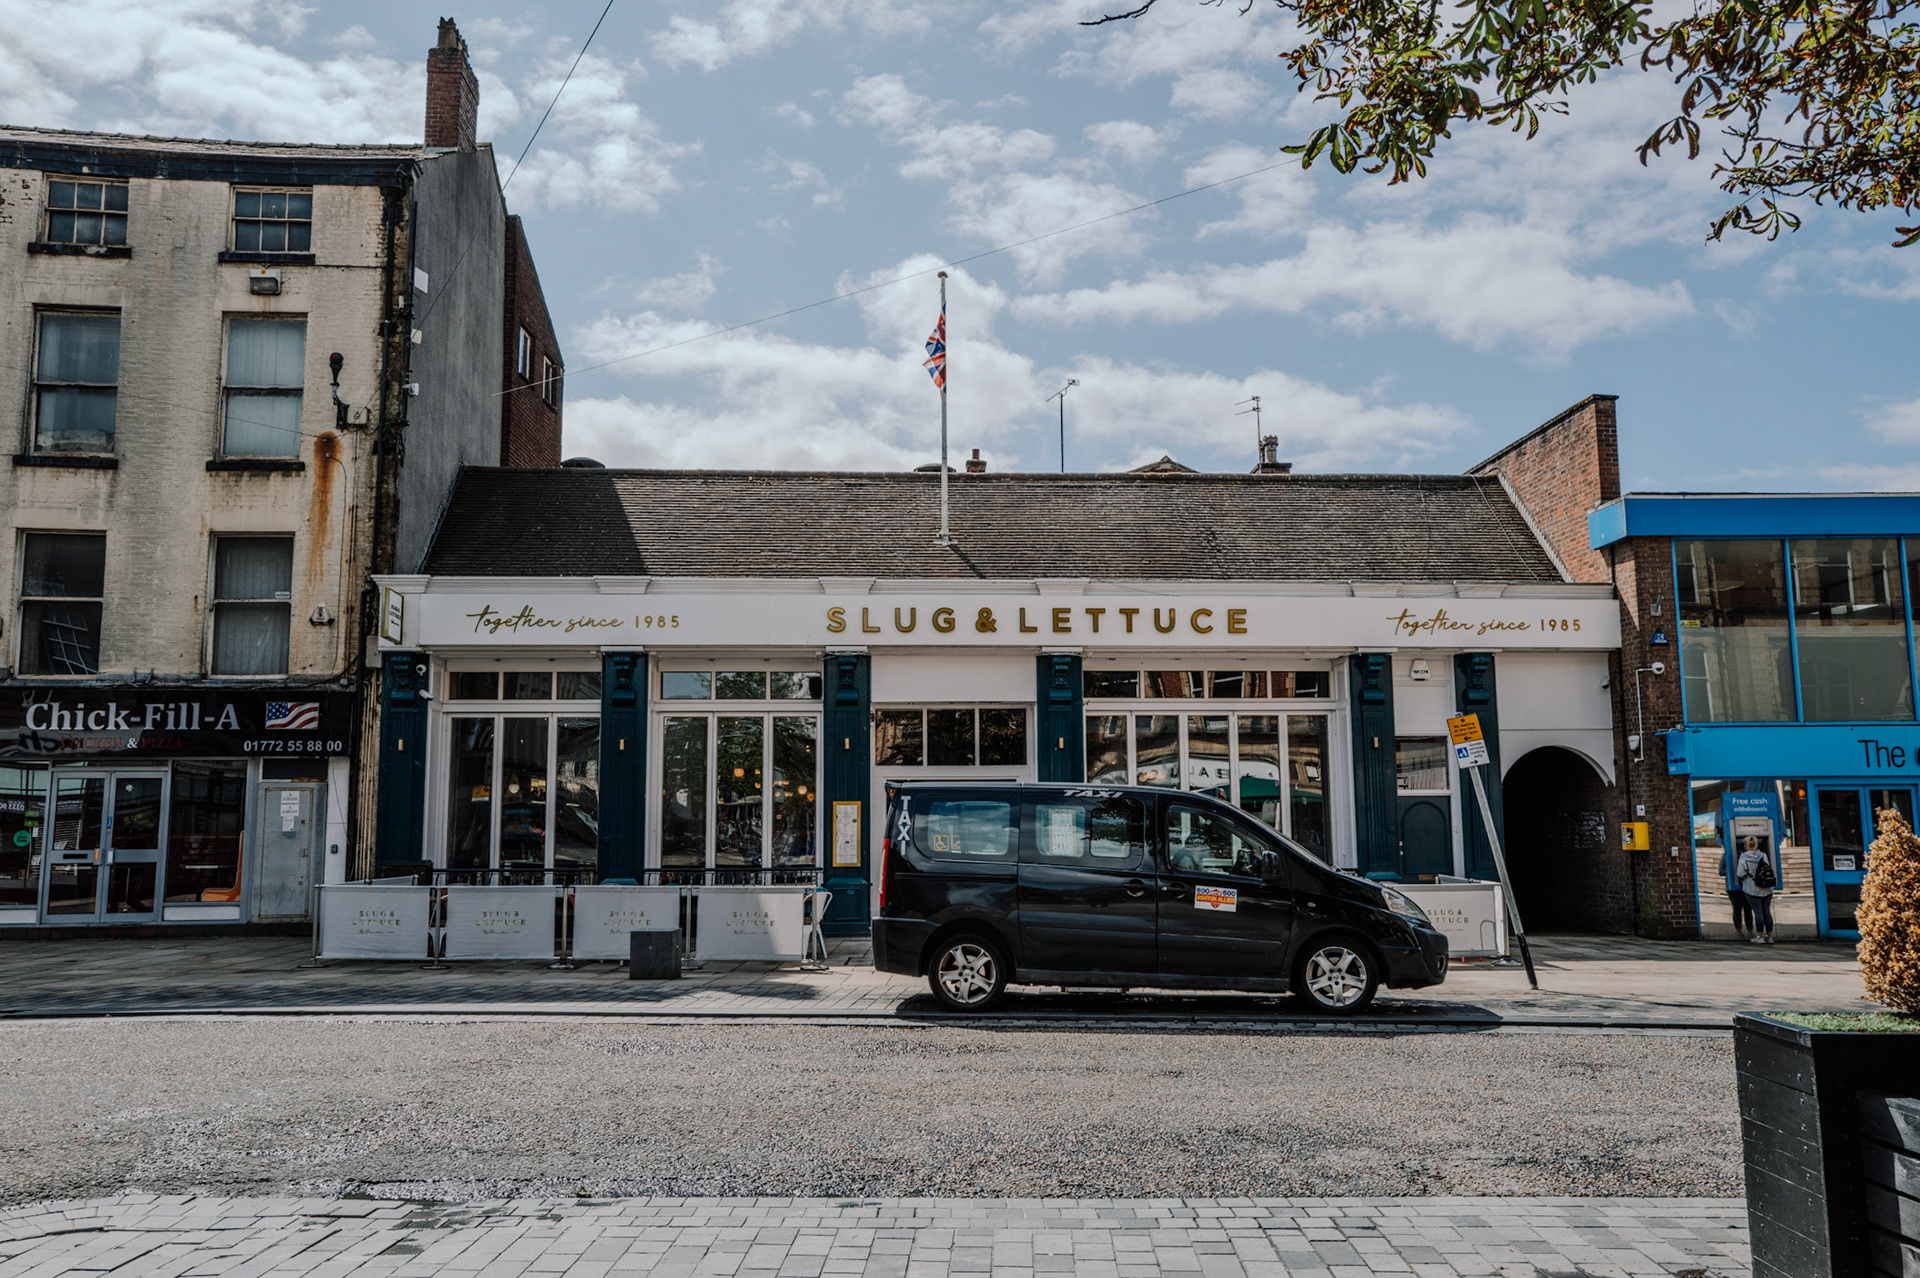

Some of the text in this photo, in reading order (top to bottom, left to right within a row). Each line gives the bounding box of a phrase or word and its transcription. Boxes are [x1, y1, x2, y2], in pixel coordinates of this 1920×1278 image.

[466, 604, 680, 634] together since 1985
[827, 607, 1248, 634] SLUG & LETTUCE
[1386, 608, 1581, 636] together since 1985
[26, 702, 241, 730] Chick-Fill-A
[59, 737, 183, 749] CHICKEN & PIZZA
[244, 741, 342, 752] 01772 55 88 00
[1857, 739, 1905, 768] The
[1063, 789, 1123, 798] TAXI
[1732, 797, 1767, 805] Free cash
[897, 796, 911, 856] TAXI
[1217, 896, 1235, 904] ALLIED
